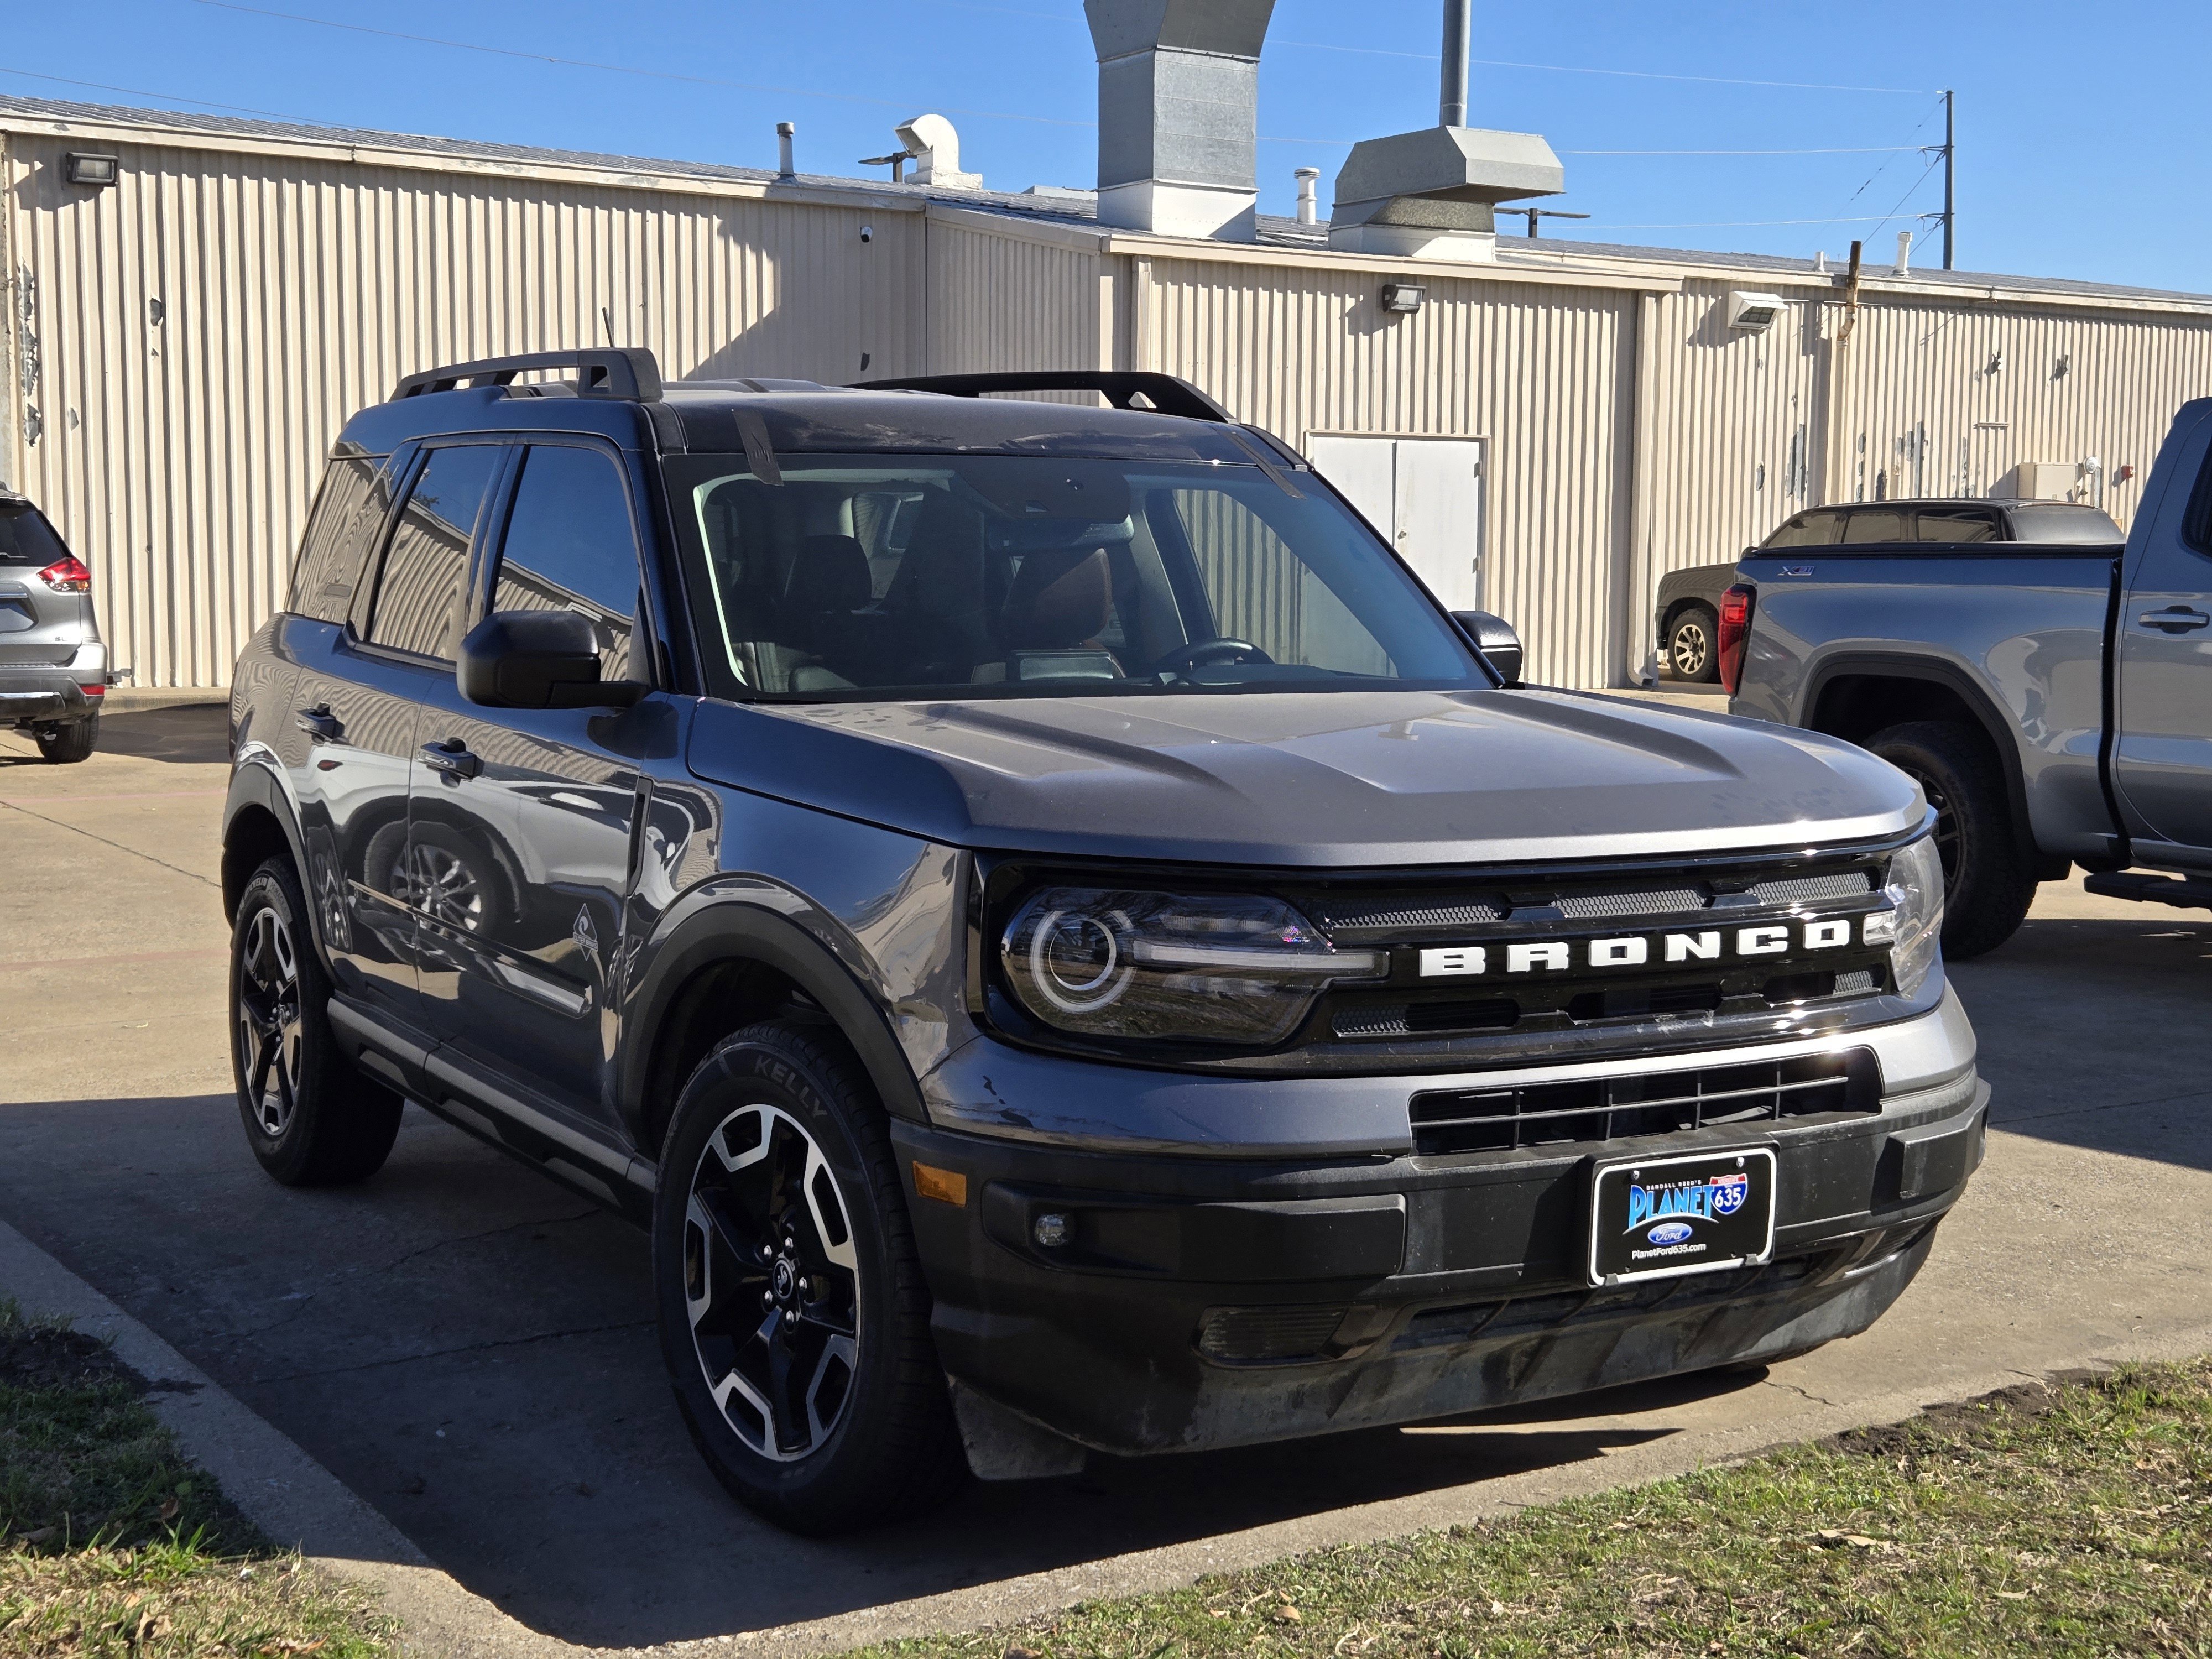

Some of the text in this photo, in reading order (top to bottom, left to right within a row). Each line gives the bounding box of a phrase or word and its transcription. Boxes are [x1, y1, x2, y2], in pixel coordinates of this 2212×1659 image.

[1419, 920, 1851, 977] BRONCO
[754, 1054, 828, 1118] KELLY
[1628, 1185, 1714, 1229] PLANET
[1715, 1187, 1741, 1207] 635
[1655, 1227, 1683, 1241] Ford
[1631, 1243, 1707, 1260] PlanetFord635.com
